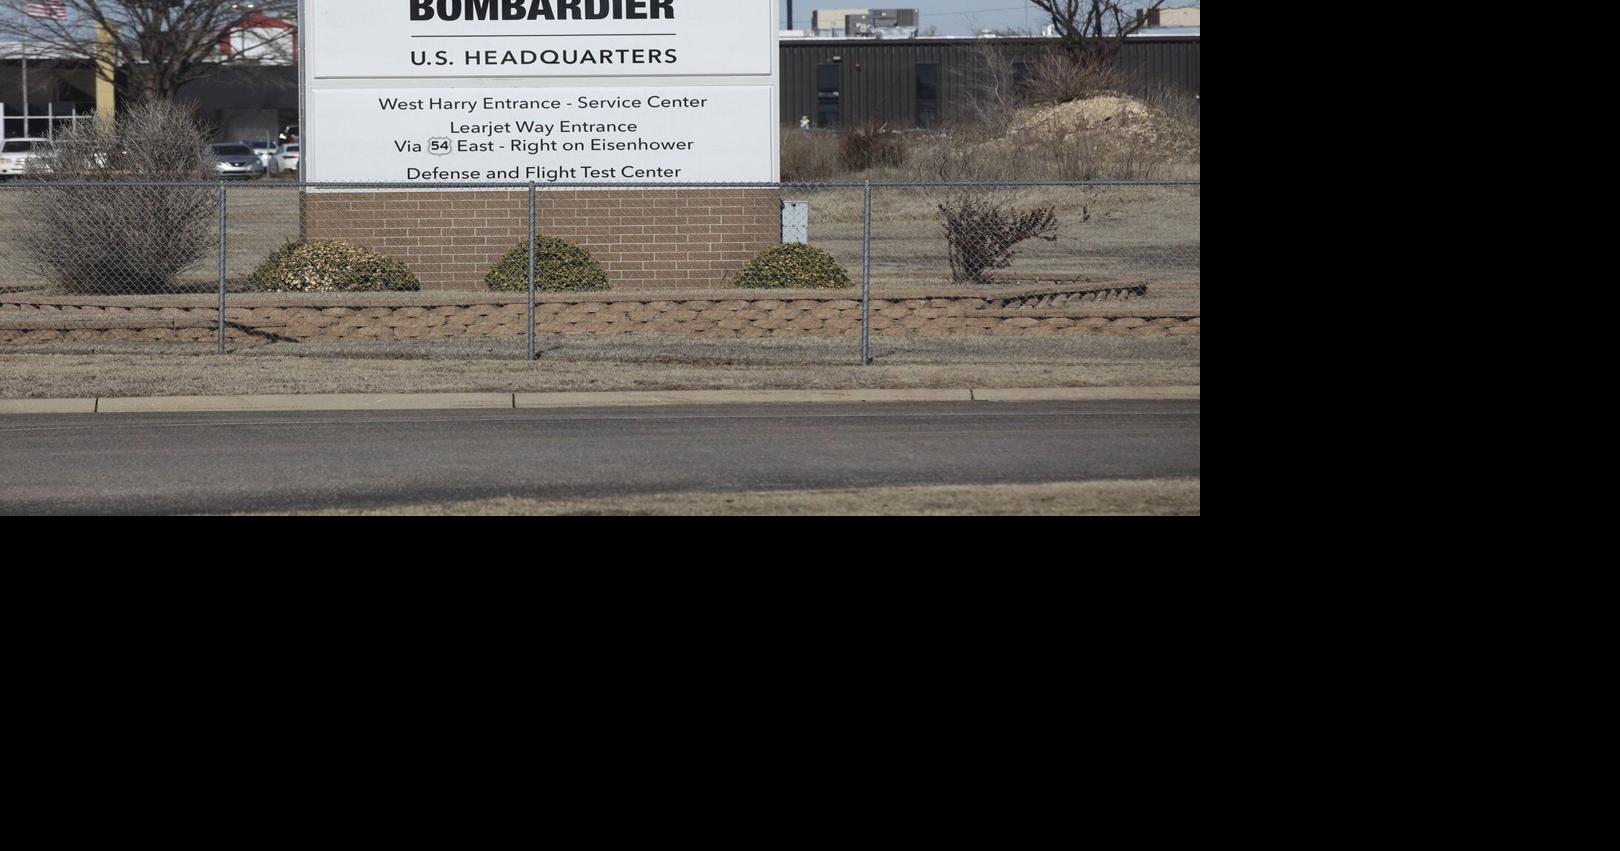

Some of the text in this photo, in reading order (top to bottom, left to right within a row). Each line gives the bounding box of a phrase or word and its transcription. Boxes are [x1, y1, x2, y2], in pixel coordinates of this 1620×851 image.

[411, 48, 678, 66] U.S. HEADQUARTERS
[378, 97, 424, 111] West
[429, 97, 478, 114] Harry
[483, 97, 561, 110] Entrance
[577, 96, 642, 109] Service
[647, 95, 708, 109] Center
[450, 120, 638, 137] Learjet Way Entrance
[394, 139, 422, 153] Via
[431, 140, 449, 151] 54
[457, 139, 495, 152] East
[510, 138, 558, 155] Right
[562, 141, 585, 152] on
[590, 138, 694, 151] Eisenhower
[406, 165, 682, 182] Defense and Flight Test Center
